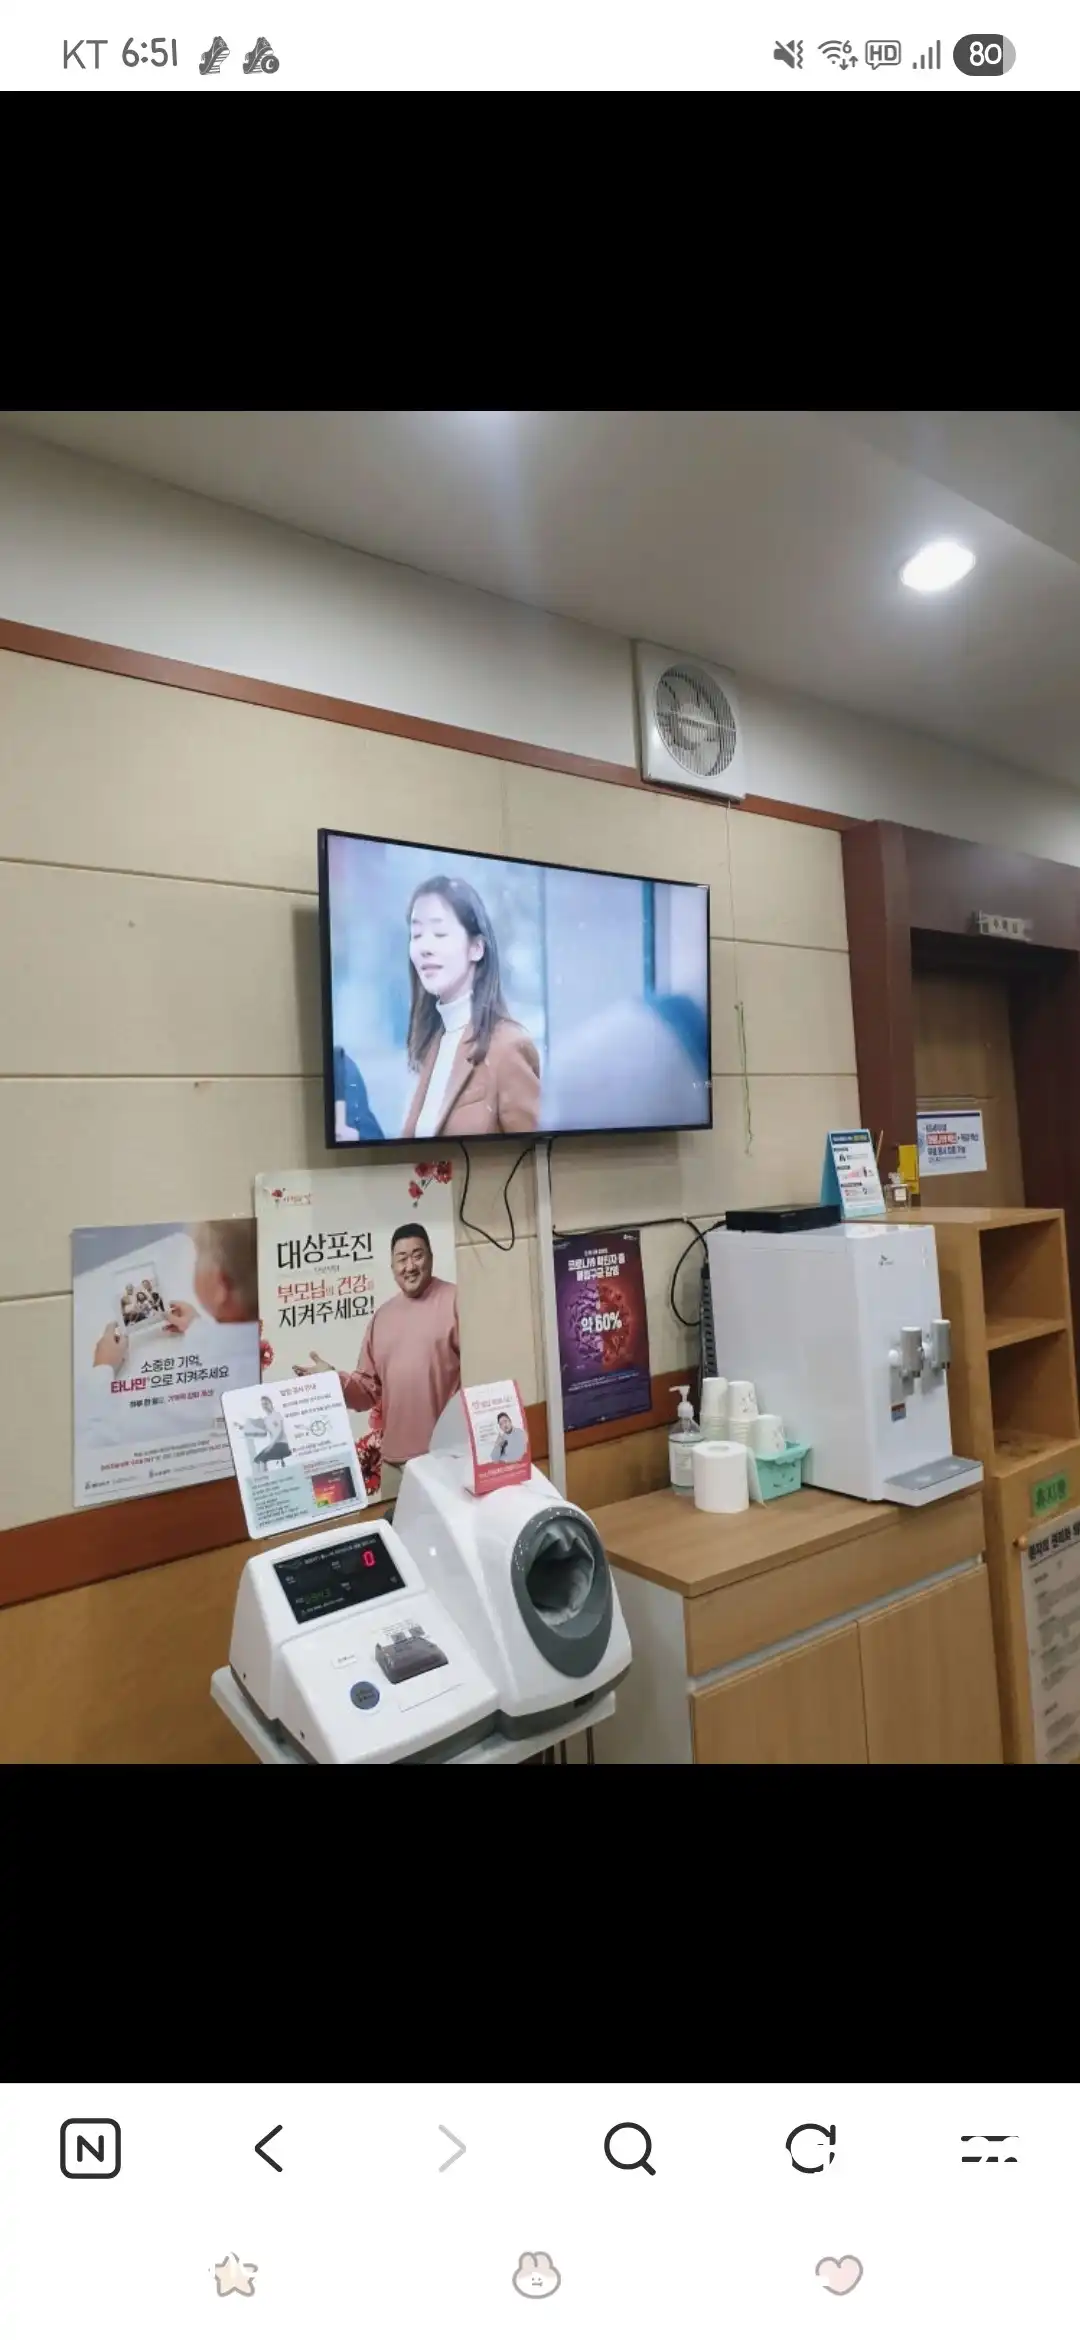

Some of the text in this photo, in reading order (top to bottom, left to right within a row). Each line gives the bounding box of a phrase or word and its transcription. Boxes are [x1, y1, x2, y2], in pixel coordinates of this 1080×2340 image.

[276, 1231, 374, 1270] 대상포진
[276, 1279, 334, 1304] 부모님의
[277, 1295, 375, 1328] 지켜주세요!
[140, 1355, 203, 1374] 소중한 기억,
[175, 1365, 230, 1384] 지켜주세요
[362, 1550, 376, 1568] 0
